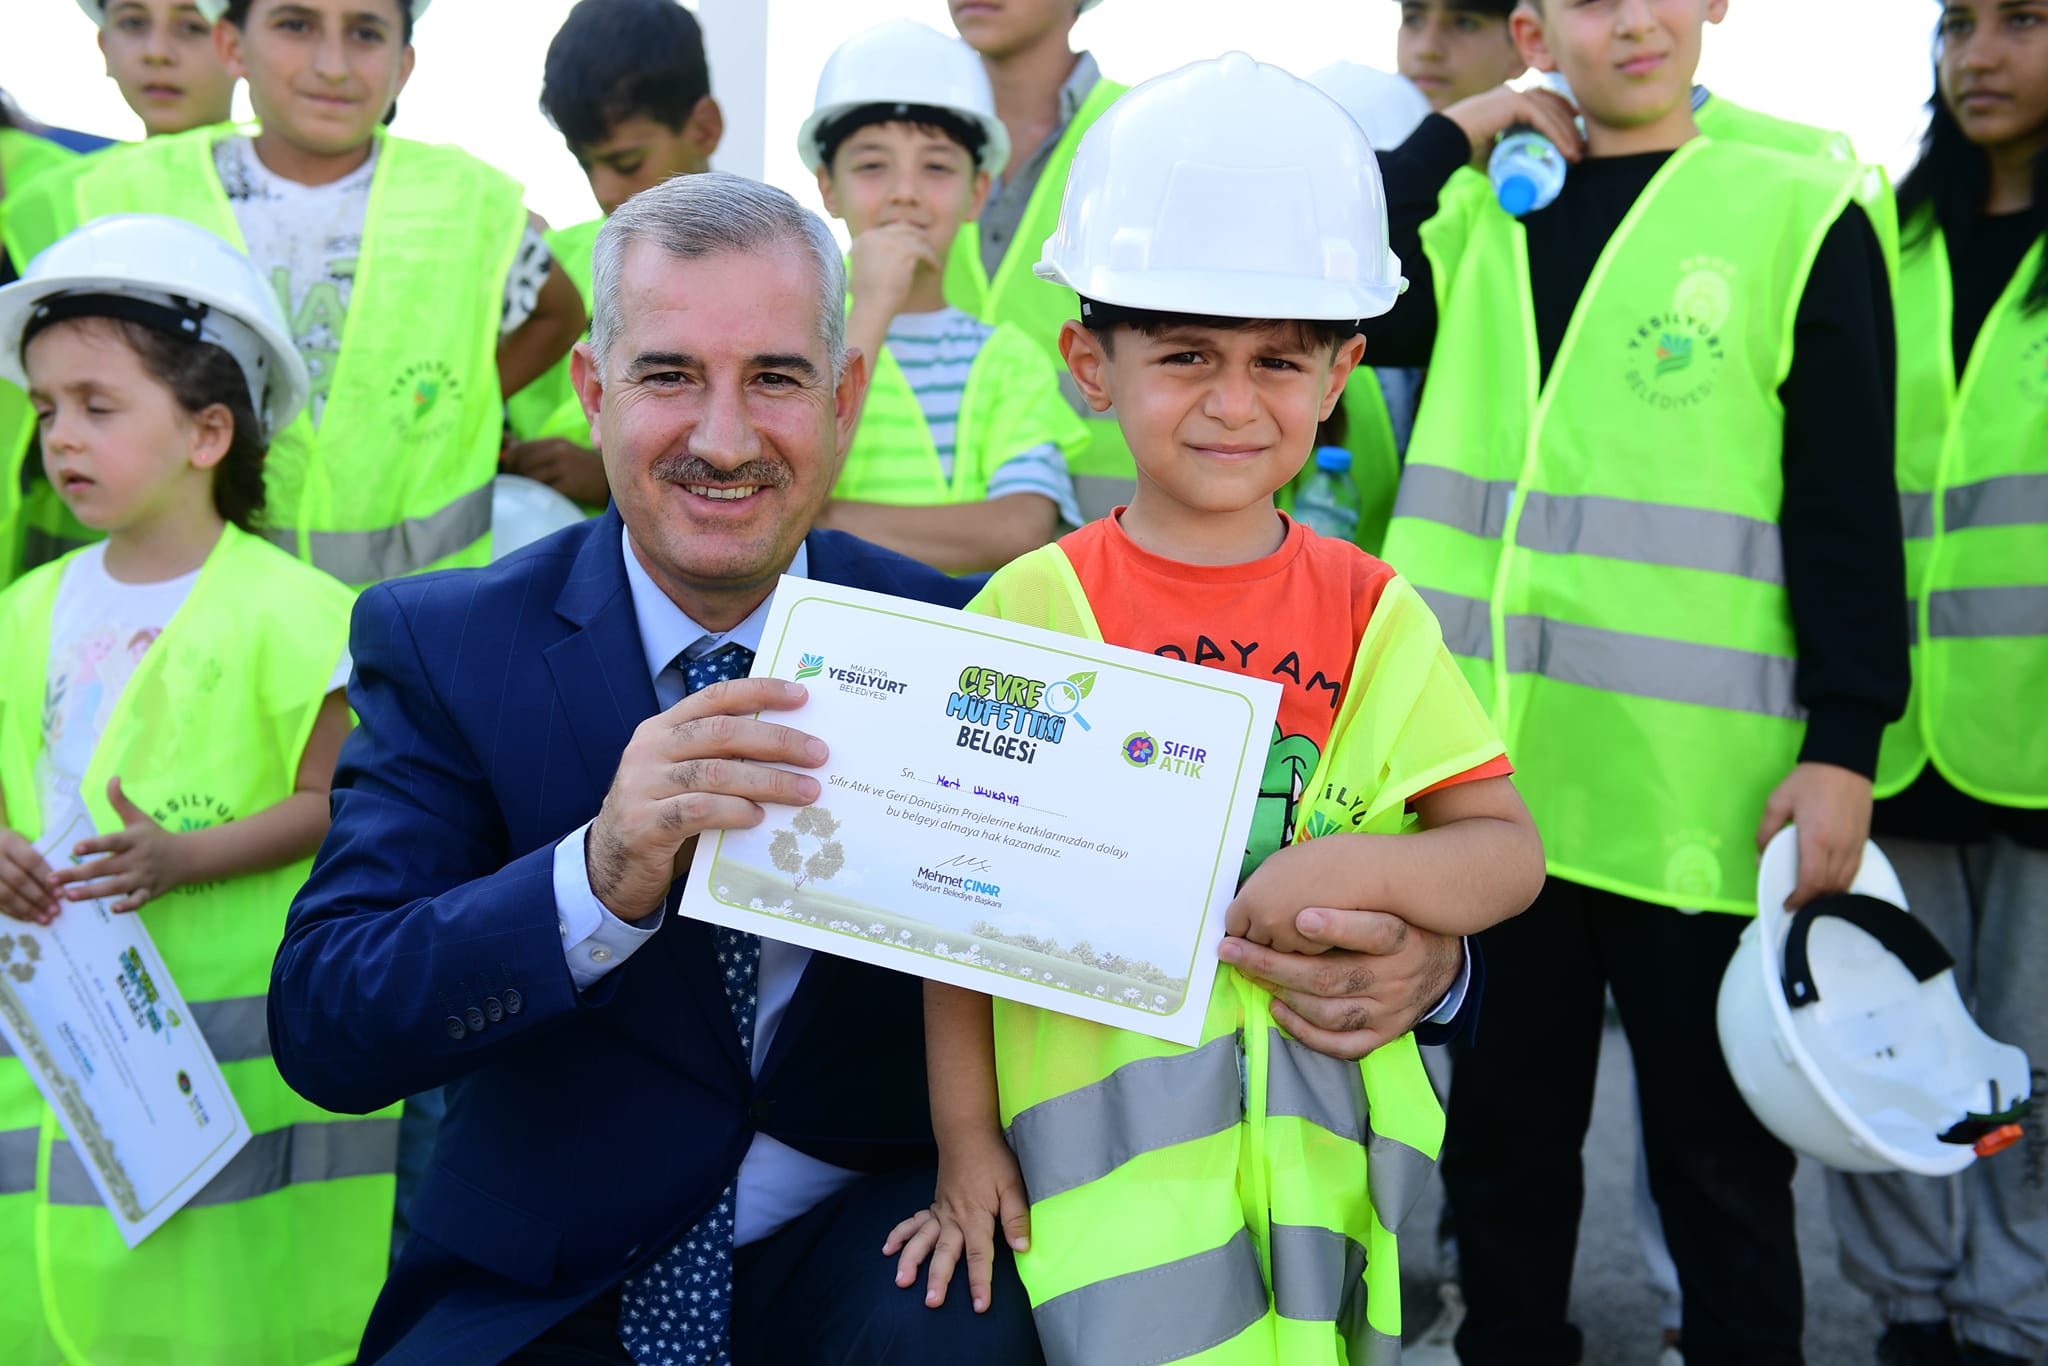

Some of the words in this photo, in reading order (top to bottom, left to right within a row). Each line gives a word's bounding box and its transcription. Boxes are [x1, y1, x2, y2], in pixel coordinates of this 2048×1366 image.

[850, 664, 888, 678] MALATYA
[1272, 651, 1341, 709] AM
[1162, 740, 1207, 764] SIFIR
[1158, 756, 1204, 779] ATIK
[872, 787, 885, 797] ve
[886, 789, 908, 803] Geri
[908, 794, 960, 814] Dönüşüm
[960, 808, 1016, 830] Projelerine
[886, 805, 900, 817] bu
[901, 809, 941, 827] belgeyi
[940, 818, 980, 837] almaya
[981, 829, 1002, 843] hak
[917, 866, 963, 888] Mehmet
[963, 878, 1001, 898] ÇINAR
[942, 887, 974, 902] Belediye
